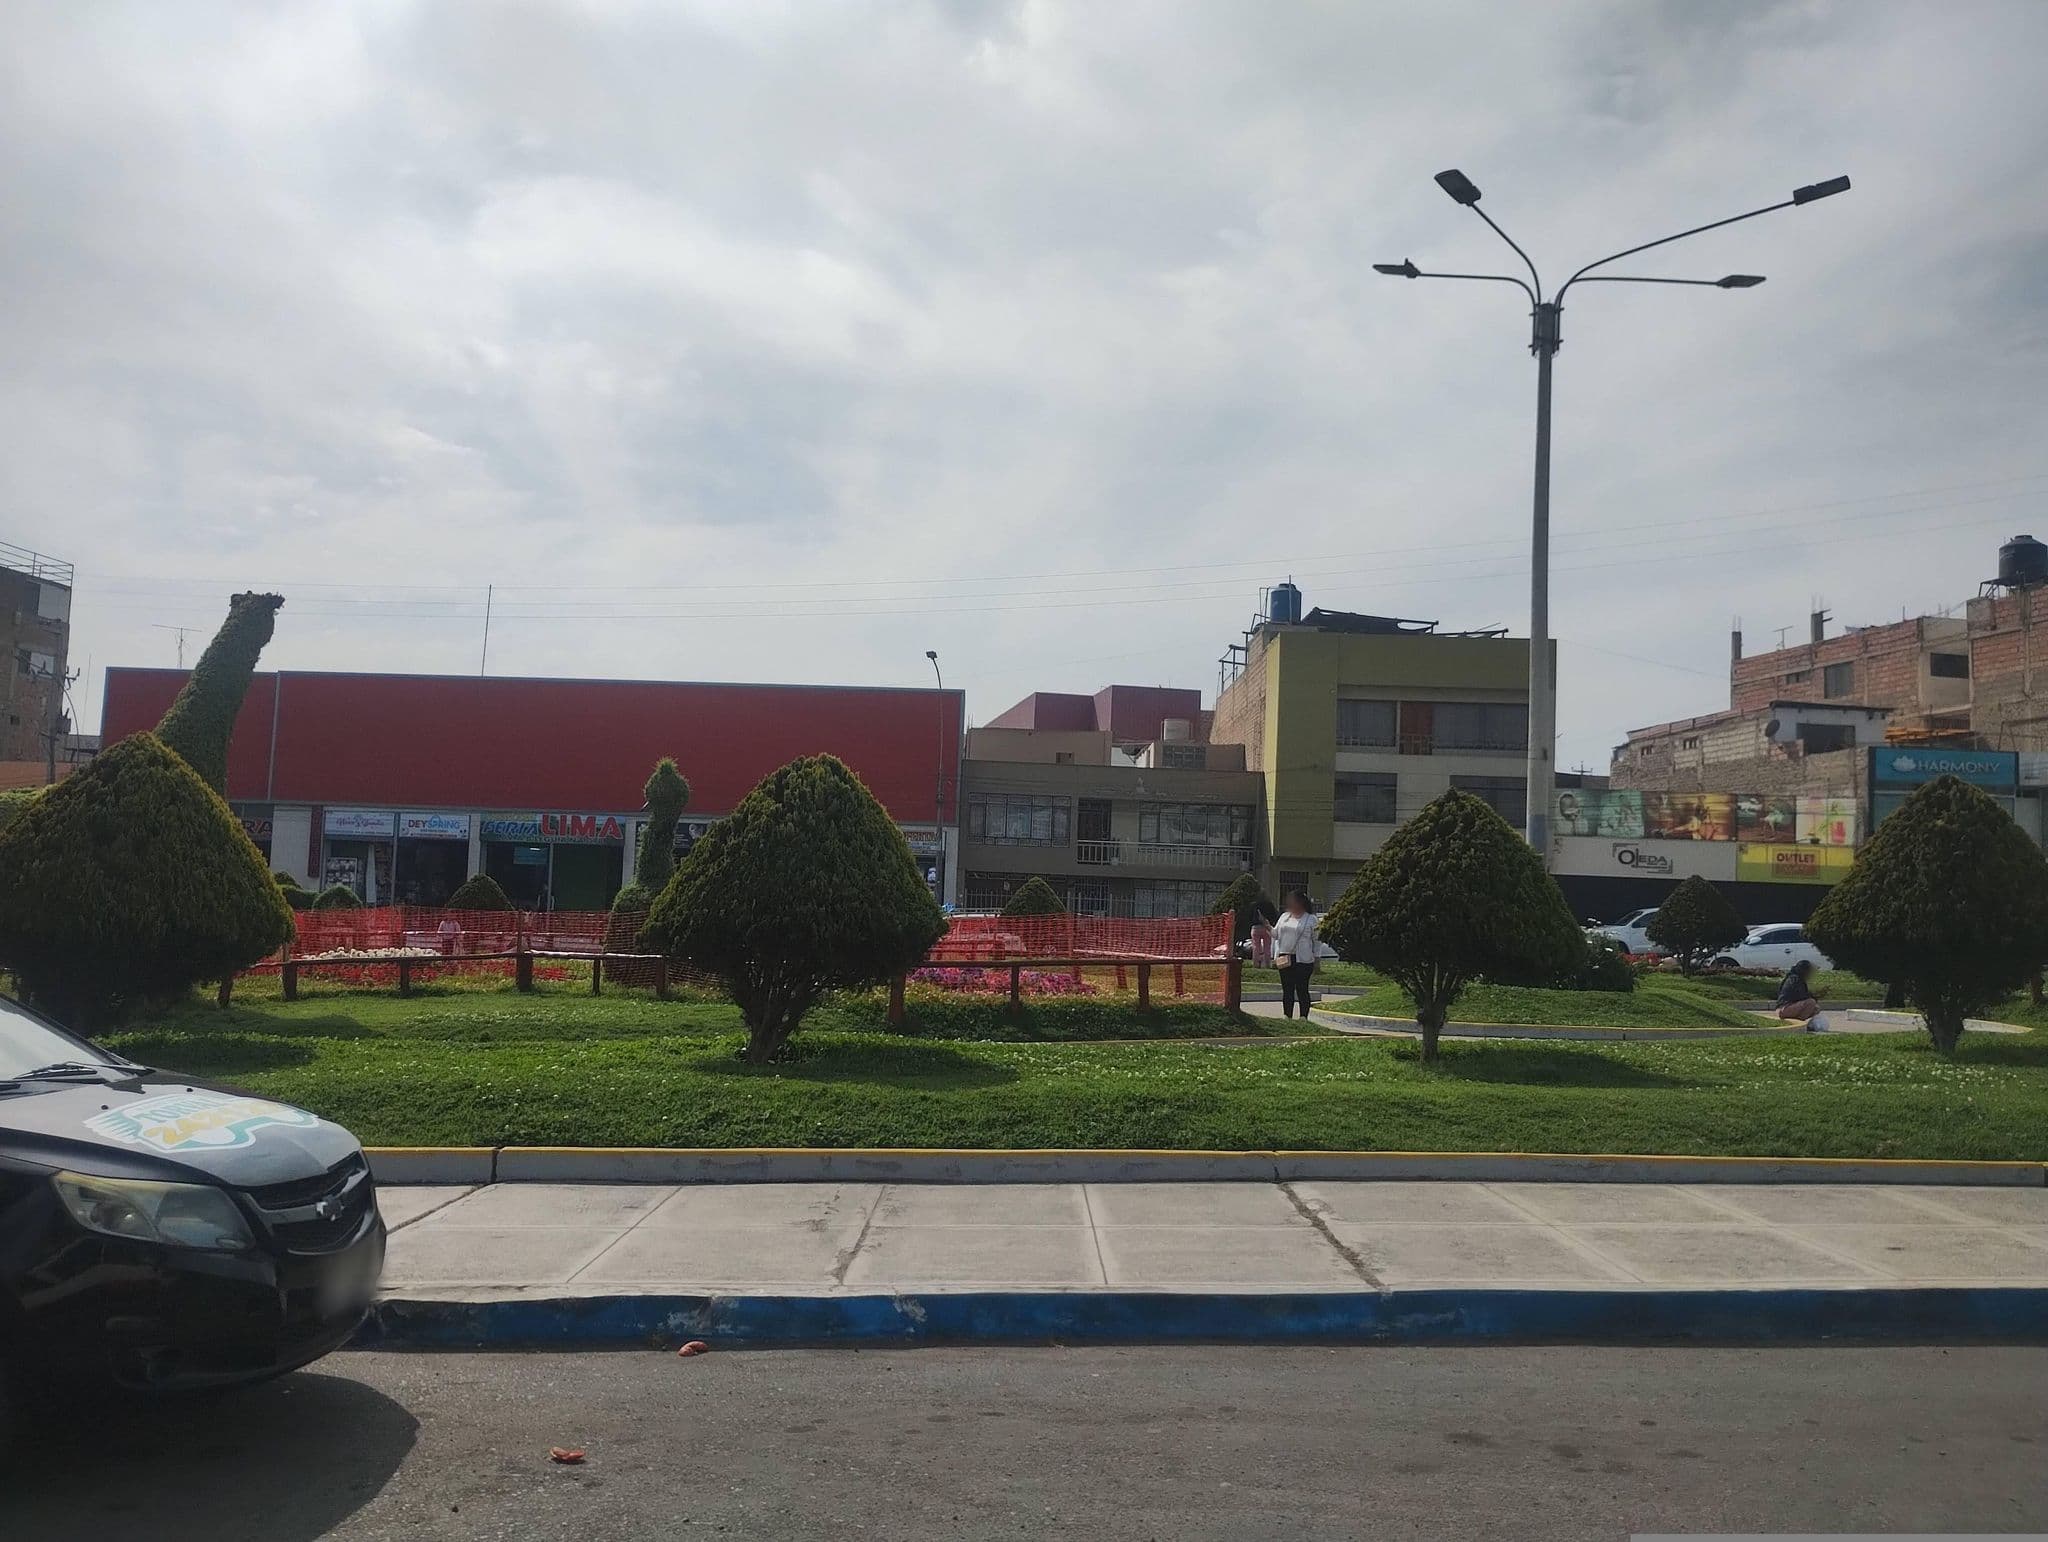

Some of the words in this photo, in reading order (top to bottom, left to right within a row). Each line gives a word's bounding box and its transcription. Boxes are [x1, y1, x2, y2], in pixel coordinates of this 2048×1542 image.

[1917, 759, 2000, 773] HARMONY
[408, 819, 460, 830] DEYSPRING
[541, 814, 623, 839] LIMA
[1776, 852, 1815, 863] OUTLET
